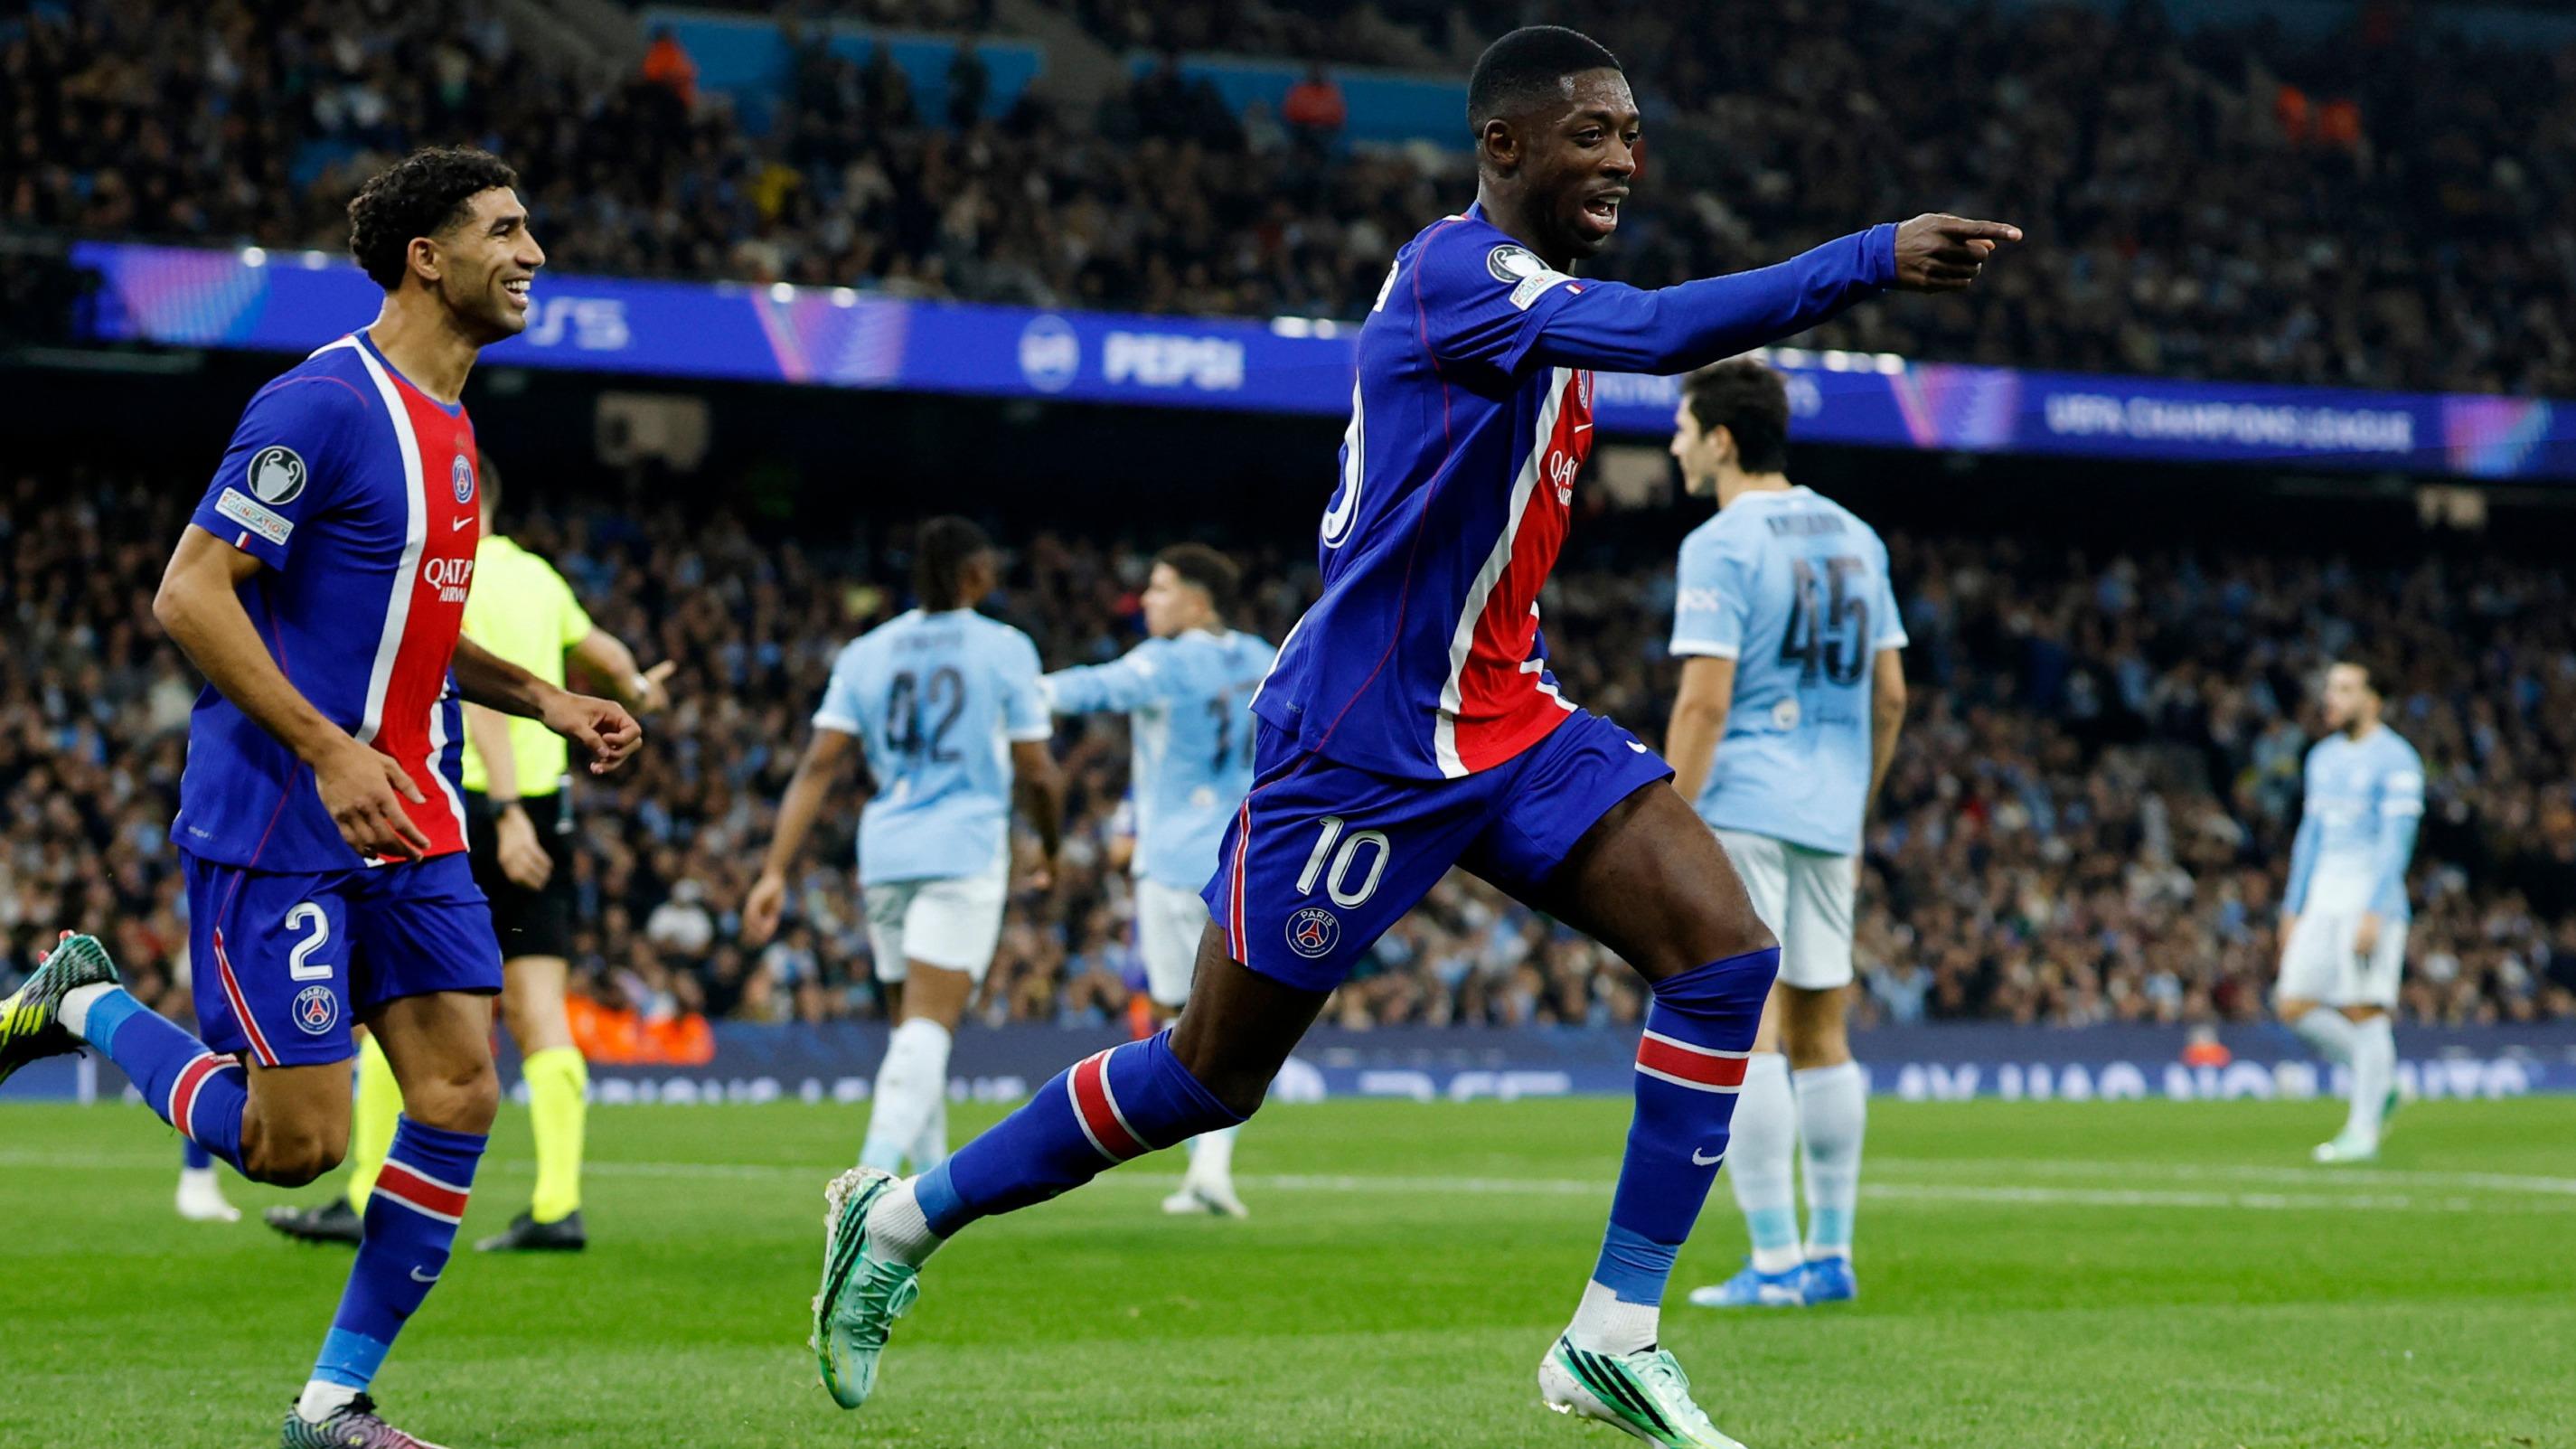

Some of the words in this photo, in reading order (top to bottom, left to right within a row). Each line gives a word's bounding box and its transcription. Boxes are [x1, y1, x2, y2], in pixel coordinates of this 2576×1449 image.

[1104, 331, 1246, 391] PEPSI
[221, 494, 288, 537] FOUNDATION
[1779, 556, 1868, 689] 45
[885, 663, 966, 763] 42
[1296, 815, 1390, 909] 10
[286, 902, 333, 981] 2
[1300, 910, 1335, 927] PARIS
[300, 987, 329, 1002] PARIS
